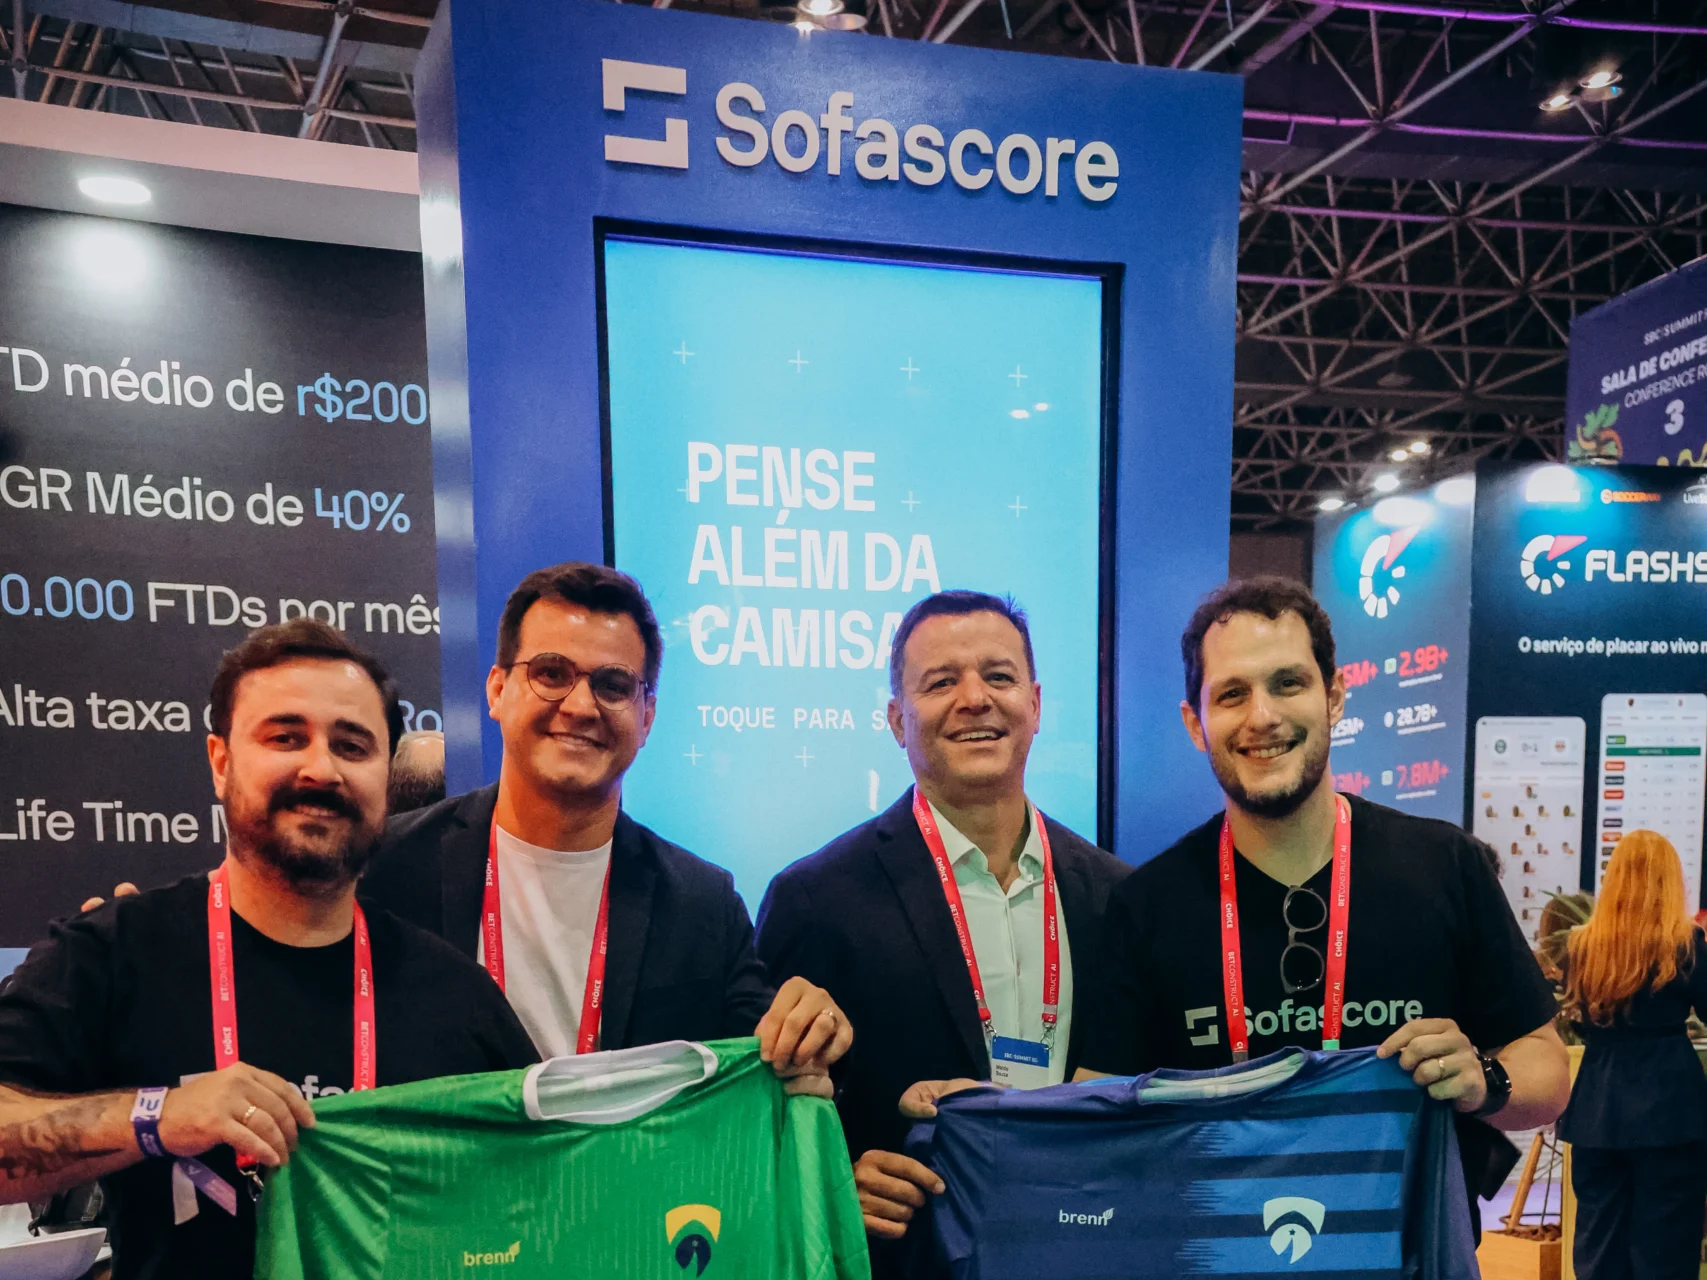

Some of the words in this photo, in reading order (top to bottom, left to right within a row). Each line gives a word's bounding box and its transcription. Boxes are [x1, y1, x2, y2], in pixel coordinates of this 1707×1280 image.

[714, 81, 1120, 202] Sofascore
[63, 357, 214, 408] médio
[225, 368, 284, 414] de
[297, 372, 427, 425] r$200
[1601, 365, 1637, 394] SALA
[1639, 356, 1658, 380] DE
[1624, 367, 1696, 408] CONFERENCE
[1664, 399, 1685, 435] 3
[687, 441, 876, 512] PENSE
[86, 472, 235, 523] Médio
[246, 482, 304, 527] de
[314, 487, 411, 533] 40%
[687, 509, 849, 590] ALÉM
[865, 532, 942, 594] DA
[147, 581, 268, 628] FTDs
[279, 598, 355, 632] por
[1518, 636, 1532, 653] O
[1533, 636, 1584, 657] serviço
[1586, 637, 1605, 653] de
[1606, 637, 1649, 657] placar
[1650, 639, 1668, 654] ao
[1670, 637, 1699, 654] vivo
[86, 692, 191, 733] taxa
[697, 705, 776, 732] TOQUE
[794, 708, 855, 730] PARA
[82, 800, 199, 843] Time
[1338, 853, 1347, 907] BETCONSTRUCT
[1227, 951, 1239, 1004] BETCONSTRUCT
[1059, 1209, 1108, 1226] brenn
[464, 1249, 516, 1267] brenn
